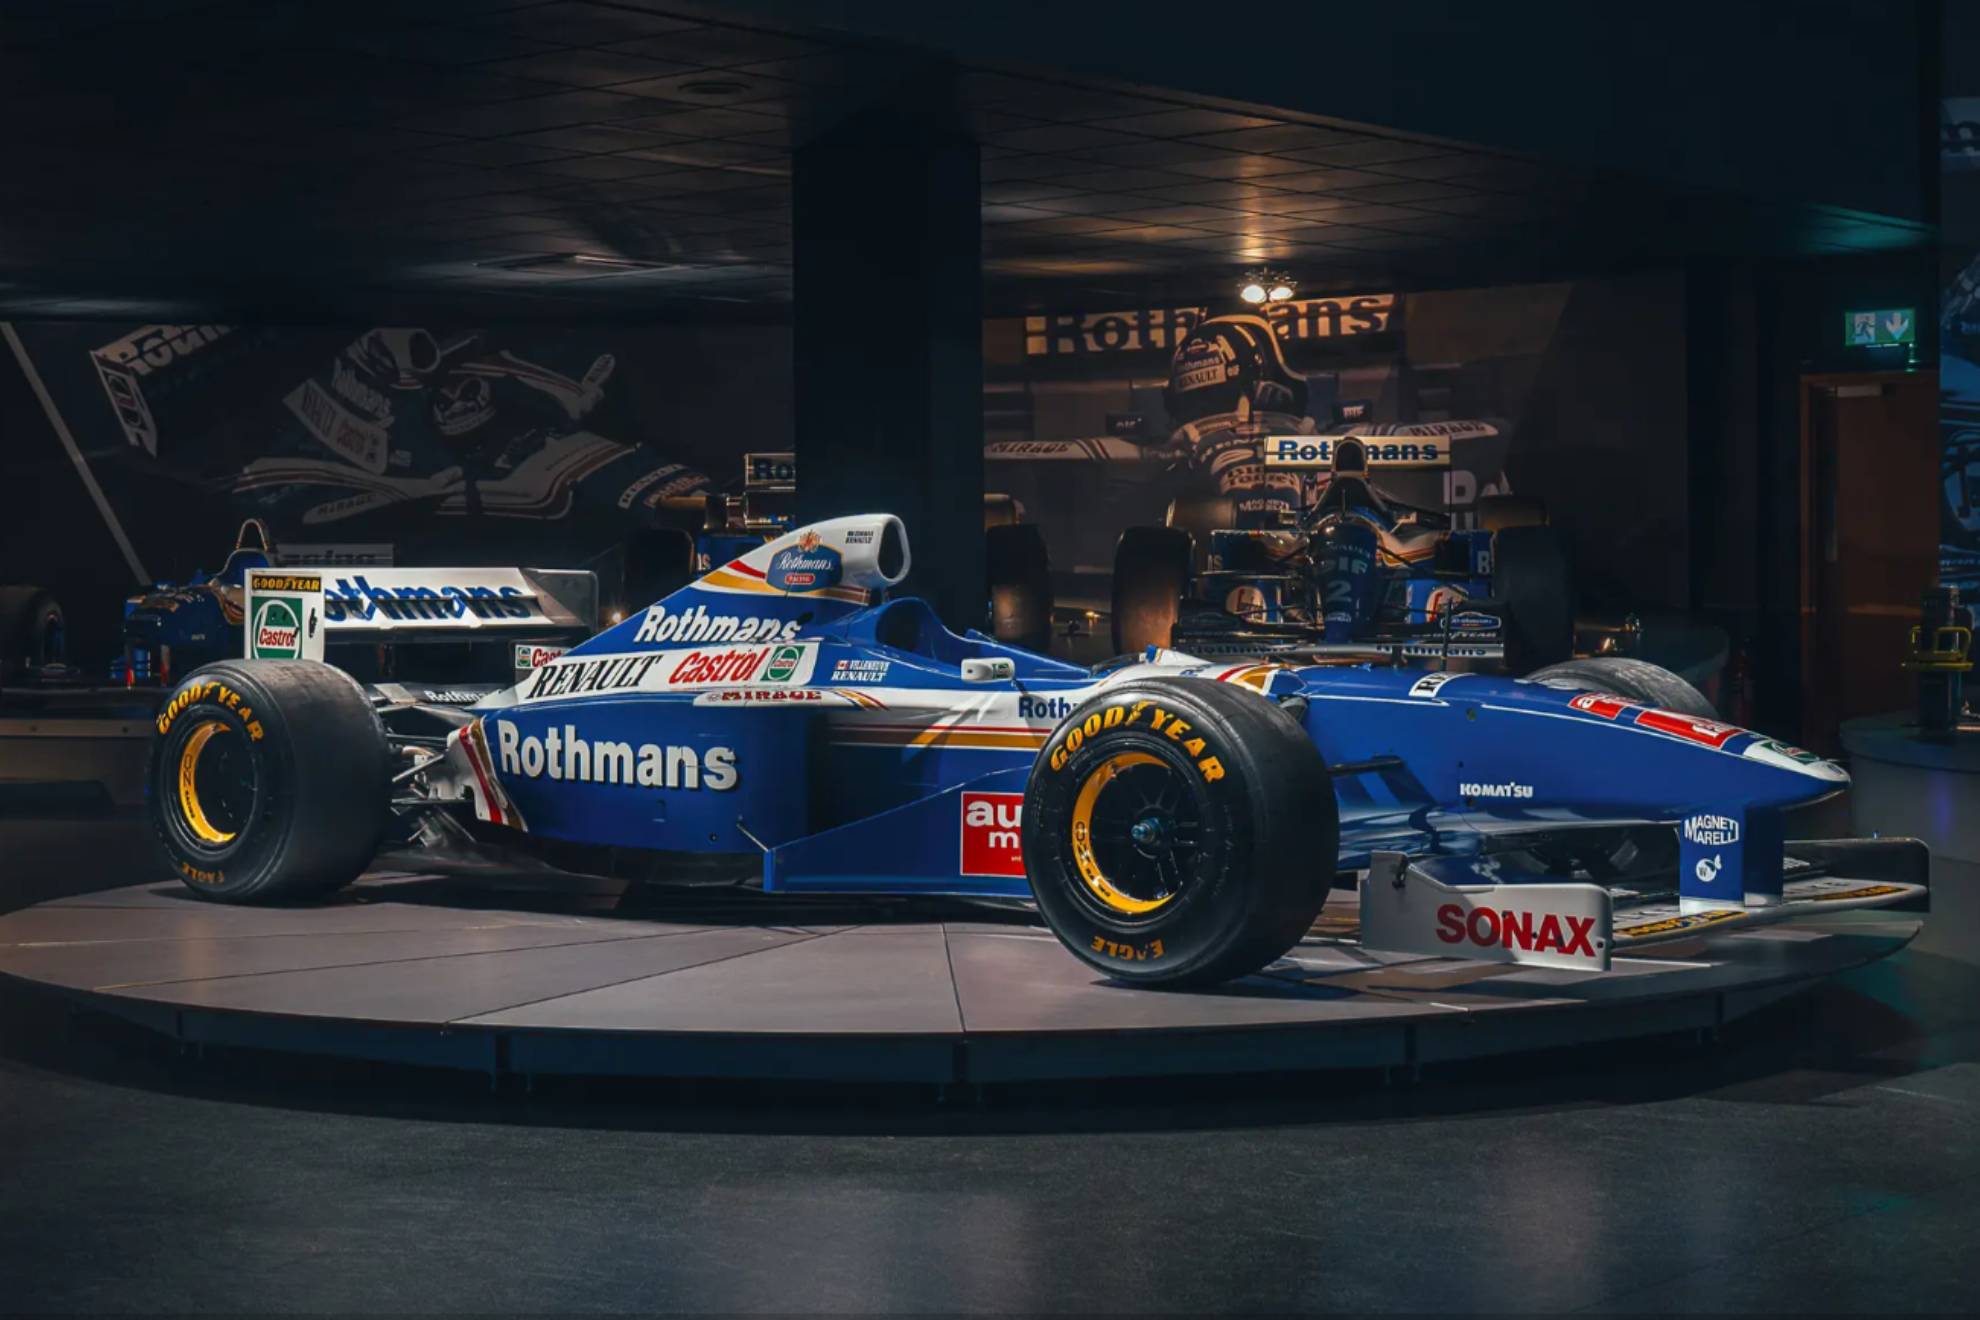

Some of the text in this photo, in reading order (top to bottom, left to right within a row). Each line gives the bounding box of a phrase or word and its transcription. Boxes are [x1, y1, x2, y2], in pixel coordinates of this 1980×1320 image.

[1046, 297, 1389, 353] Rothans
[1279, 440, 1438, 460] Rotans
[253, 576, 320, 590] GOODYEAR
[325, 575, 531, 622] othmans
[634, 605, 802, 642] Rothmans
[527, 655, 663, 699] RENAULT
[669, 646, 770, 684] Castrol
[831, 670, 887, 682] RENAULT
[721, 691, 822, 702] MIRAGE
[1018, 696, 1080, 719] Roth
[497, 719, 738, 790] Rothmans
[1050, 700, 1226, 784] GOODYEAR
[1460, 781, 1533, 798] KOMATSU
[1436, 903, 1597, 958] SONAX
